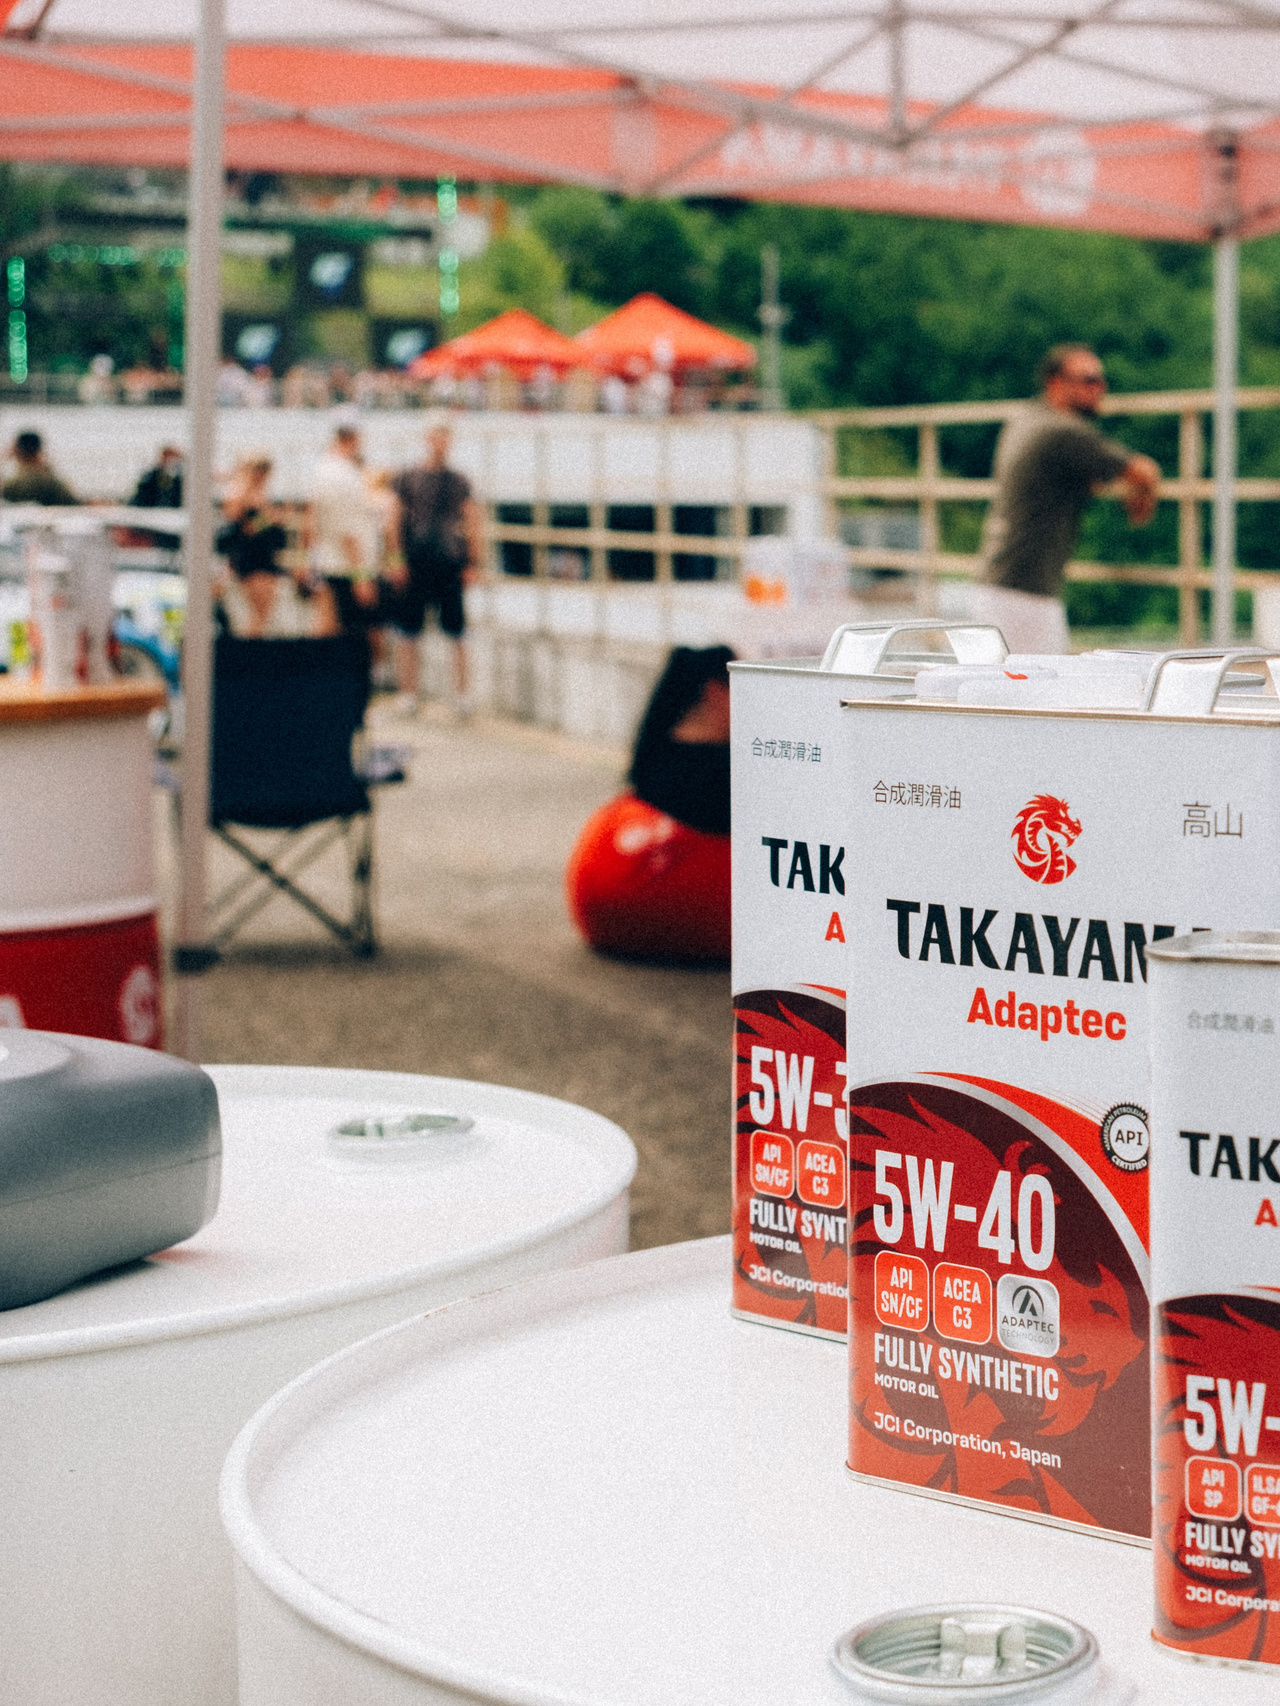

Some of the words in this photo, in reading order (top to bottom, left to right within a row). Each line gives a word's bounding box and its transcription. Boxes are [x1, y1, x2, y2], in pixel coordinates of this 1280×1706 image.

[751, 737, 822, 763] 合成潤滑油
[873, 780, 962, 809] 合成潤滑油
[1183, 801, 1243, 838] 高山
[887, 898, 1212, 984] TAKAYAM
[967, 987, 1127, 1042] Adaptec
[1115, 1129, 1143, 1147] API
[763, 1142, 782, 1164] API
[805, 1151, 837, 1176] ACEA
[755, 1162, 789, 1188] SN/CF
[812, 1176, 829, 1196] C3
[750, 1198, 797, 1234] FULLY
[872, 1149, 1057, 1271] 5W-40
[750, 1232, 784, 1250] MOTOR
[785, 1242, 803, 1254] OIL
[749, 1264, 772, 1284] JCI
[890, 1266, 913, 1290] API
[943, 1276, 982, 1304] ACEA
[881, 1290, 923, 1319] SN/CF
[952, 1305, 972, 1330] C3
[1001, 1315, 1055, 1334] ADAPTEC
[1002, 1328, 1055, 1345] TECHNOLOGY
[874, 1332, 933, 1375] FULLY
[938, 1347, 1059, 1401] SYNTHETIC
[874, 1373, 916, 1394] MOTOR
[918, 1384, 939, 1399] OIL
[874, 1412, 900, 1433] JCI
[903, 1419, 1006, 1459] Corporation,
[1010, 1440, 1062, 1468] Japan
[1201, 1468, 1226, 1488] API
[1204, 1489, 1223, 1508] SP
[1185, 1521, 1246, 1555] FULLY
[1185, 1553, 1229, 1571] MOTOR
[1230, 1560, 1252, 1574] OIL
[1185, 1585, 1213, 1603] JCI
